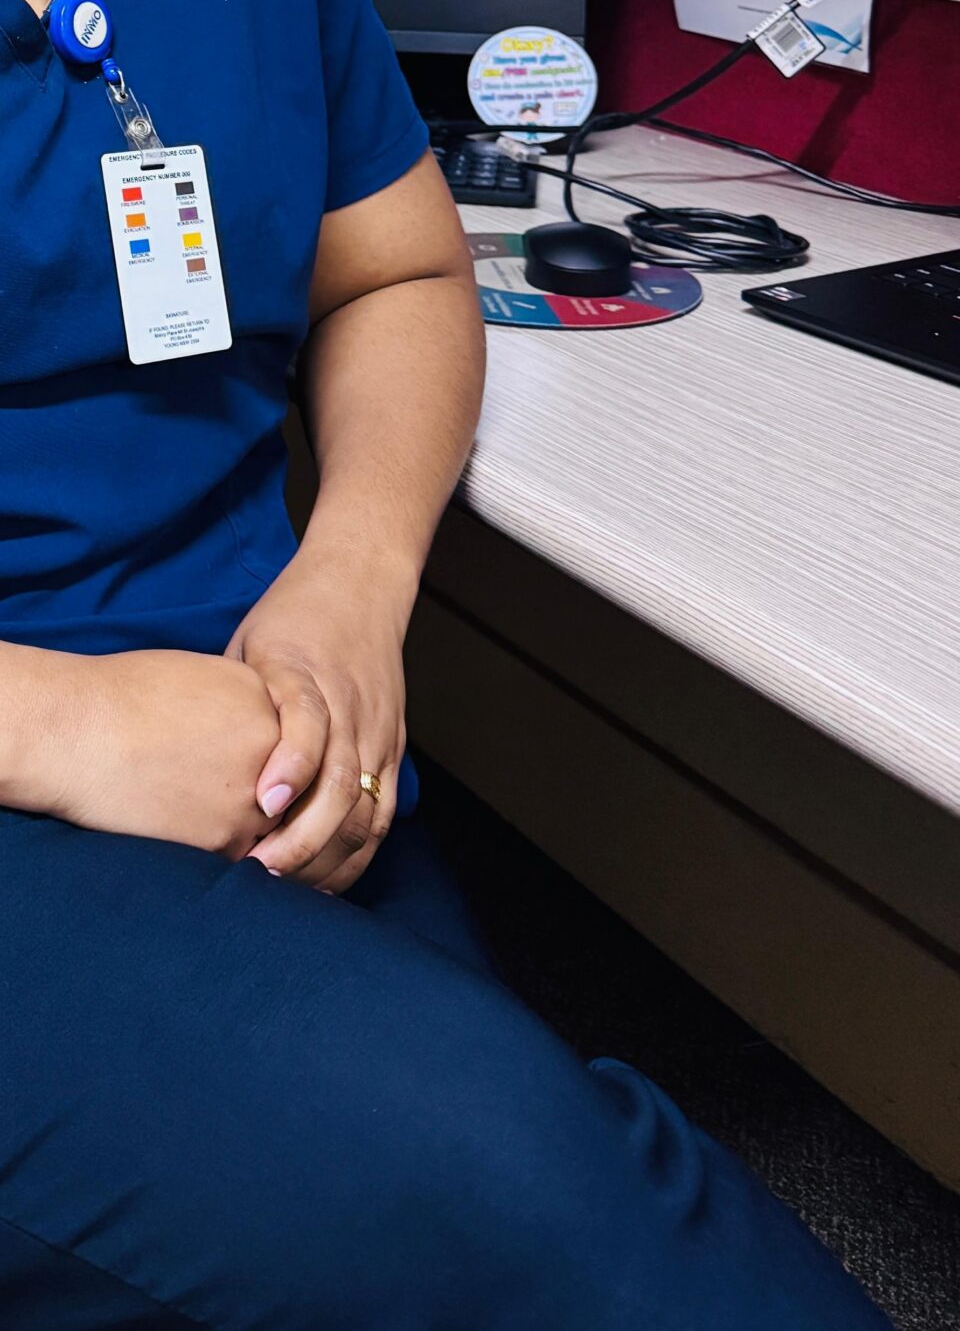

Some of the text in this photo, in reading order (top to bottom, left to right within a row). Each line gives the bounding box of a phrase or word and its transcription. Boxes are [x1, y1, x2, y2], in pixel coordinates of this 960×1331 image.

[109, 153, 142, 162] EMERGENCY
[178, 148, 197, 156] CODES
[122, 174, 157, 184] EMERGENCY
[158, 172, 181, 181] NUMBER
[128, 257, 155, 265] EMERGENCY
